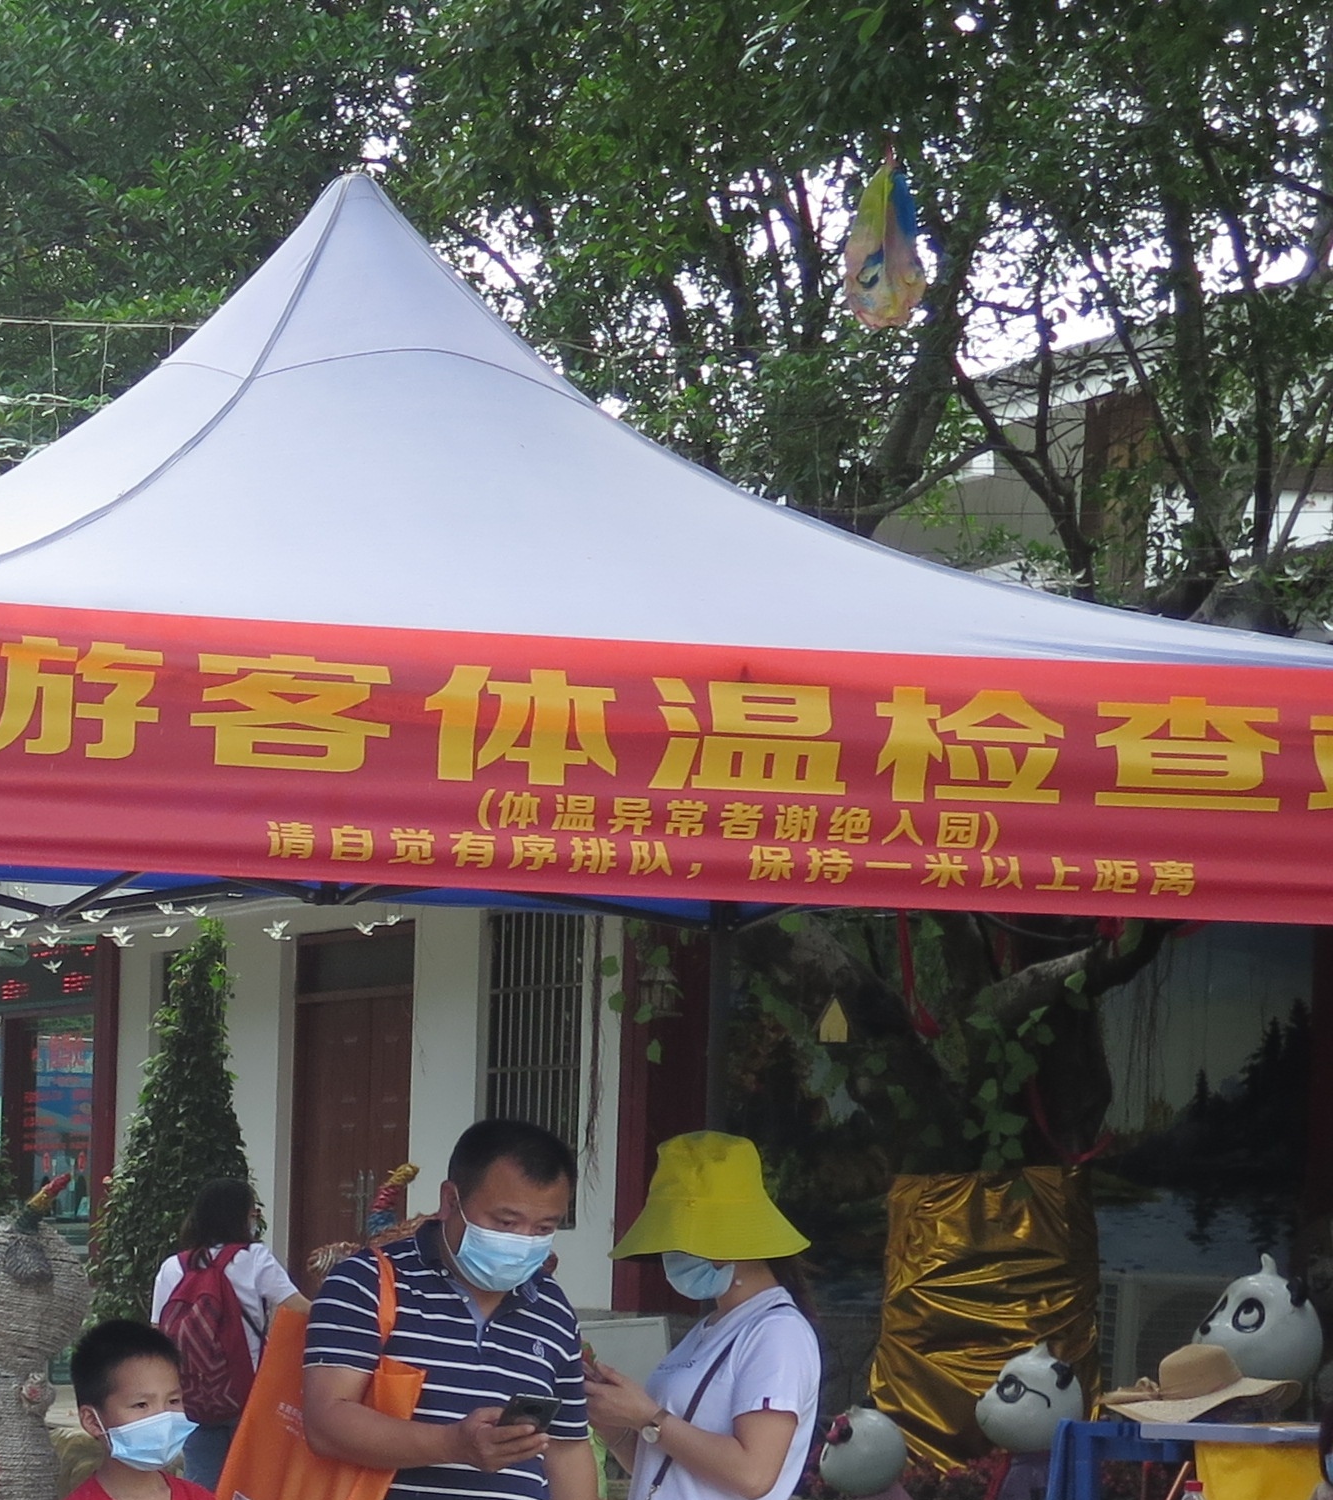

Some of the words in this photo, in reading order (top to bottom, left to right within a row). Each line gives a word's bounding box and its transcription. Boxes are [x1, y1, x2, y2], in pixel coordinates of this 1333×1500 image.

[477, 788, 1000, 853] (体温异常者谢绝入园)
